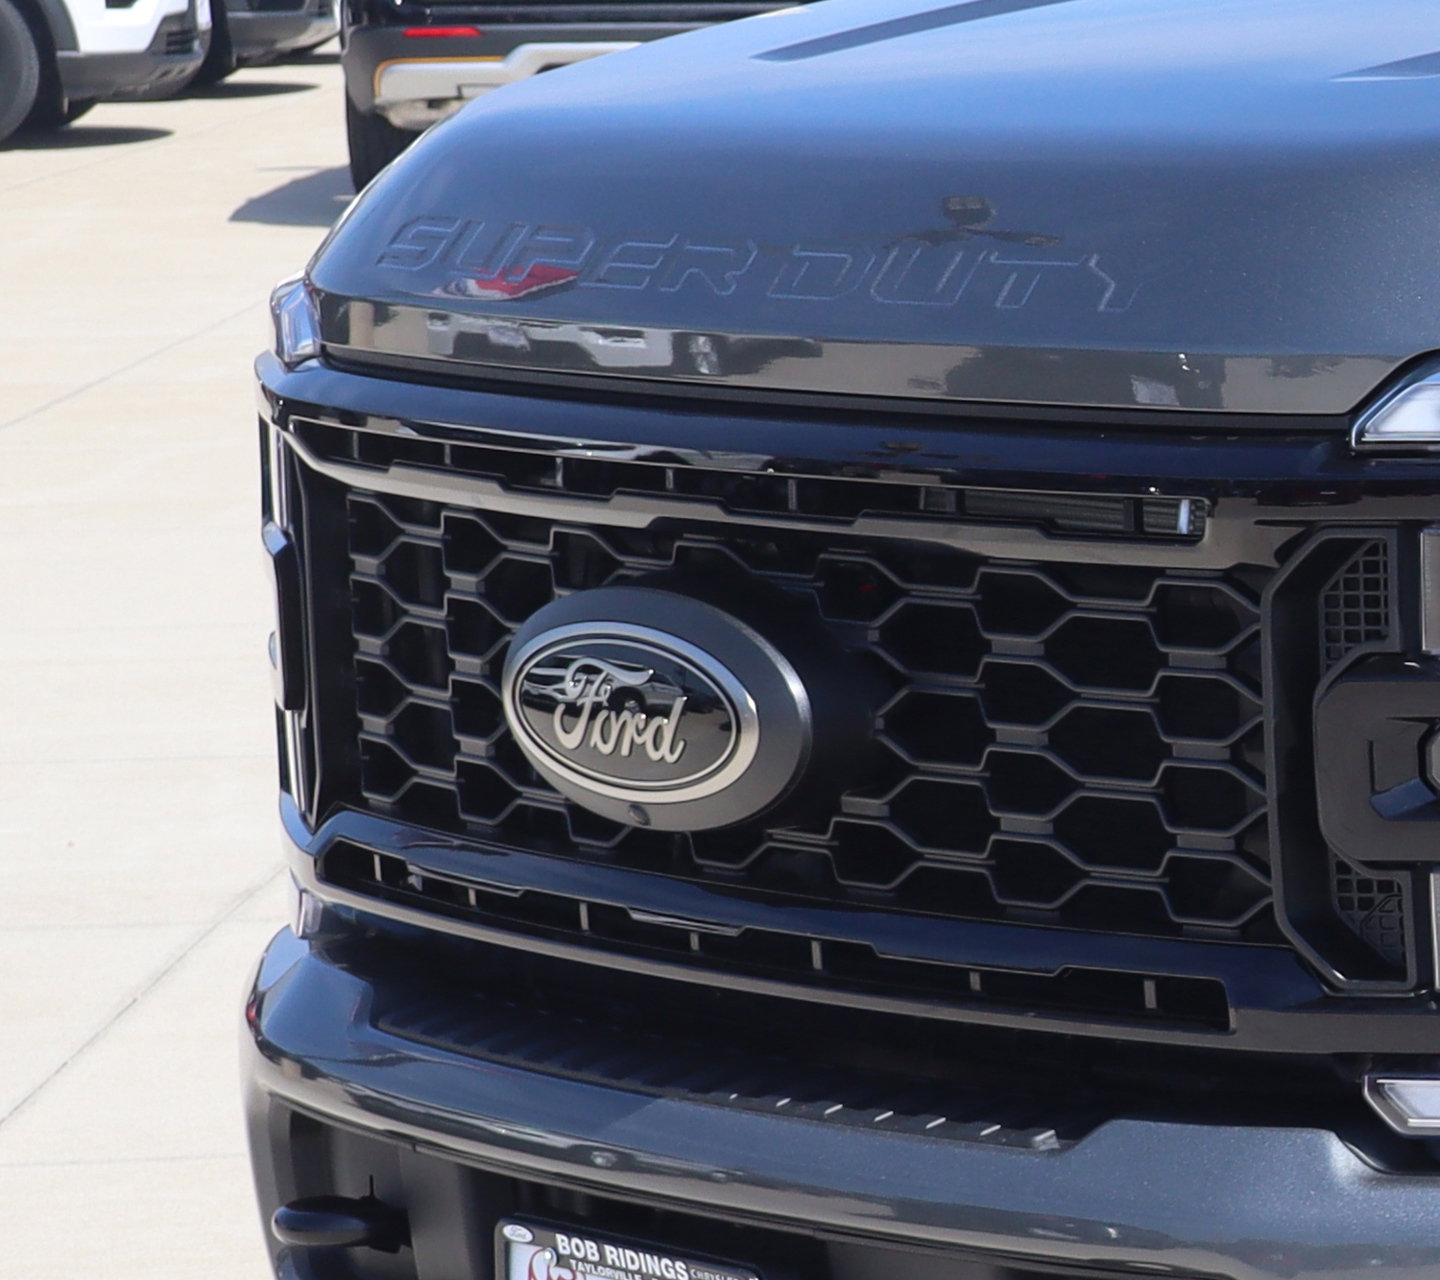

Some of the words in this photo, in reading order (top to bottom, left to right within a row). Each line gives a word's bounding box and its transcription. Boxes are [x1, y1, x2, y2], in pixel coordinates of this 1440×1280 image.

[377, 216, 758, 296] SUPER
[766, 241, 1152, 313] DUTY
[554, 657, 688, 764] Ford
[555, 1233, 600, 1262] BOB
